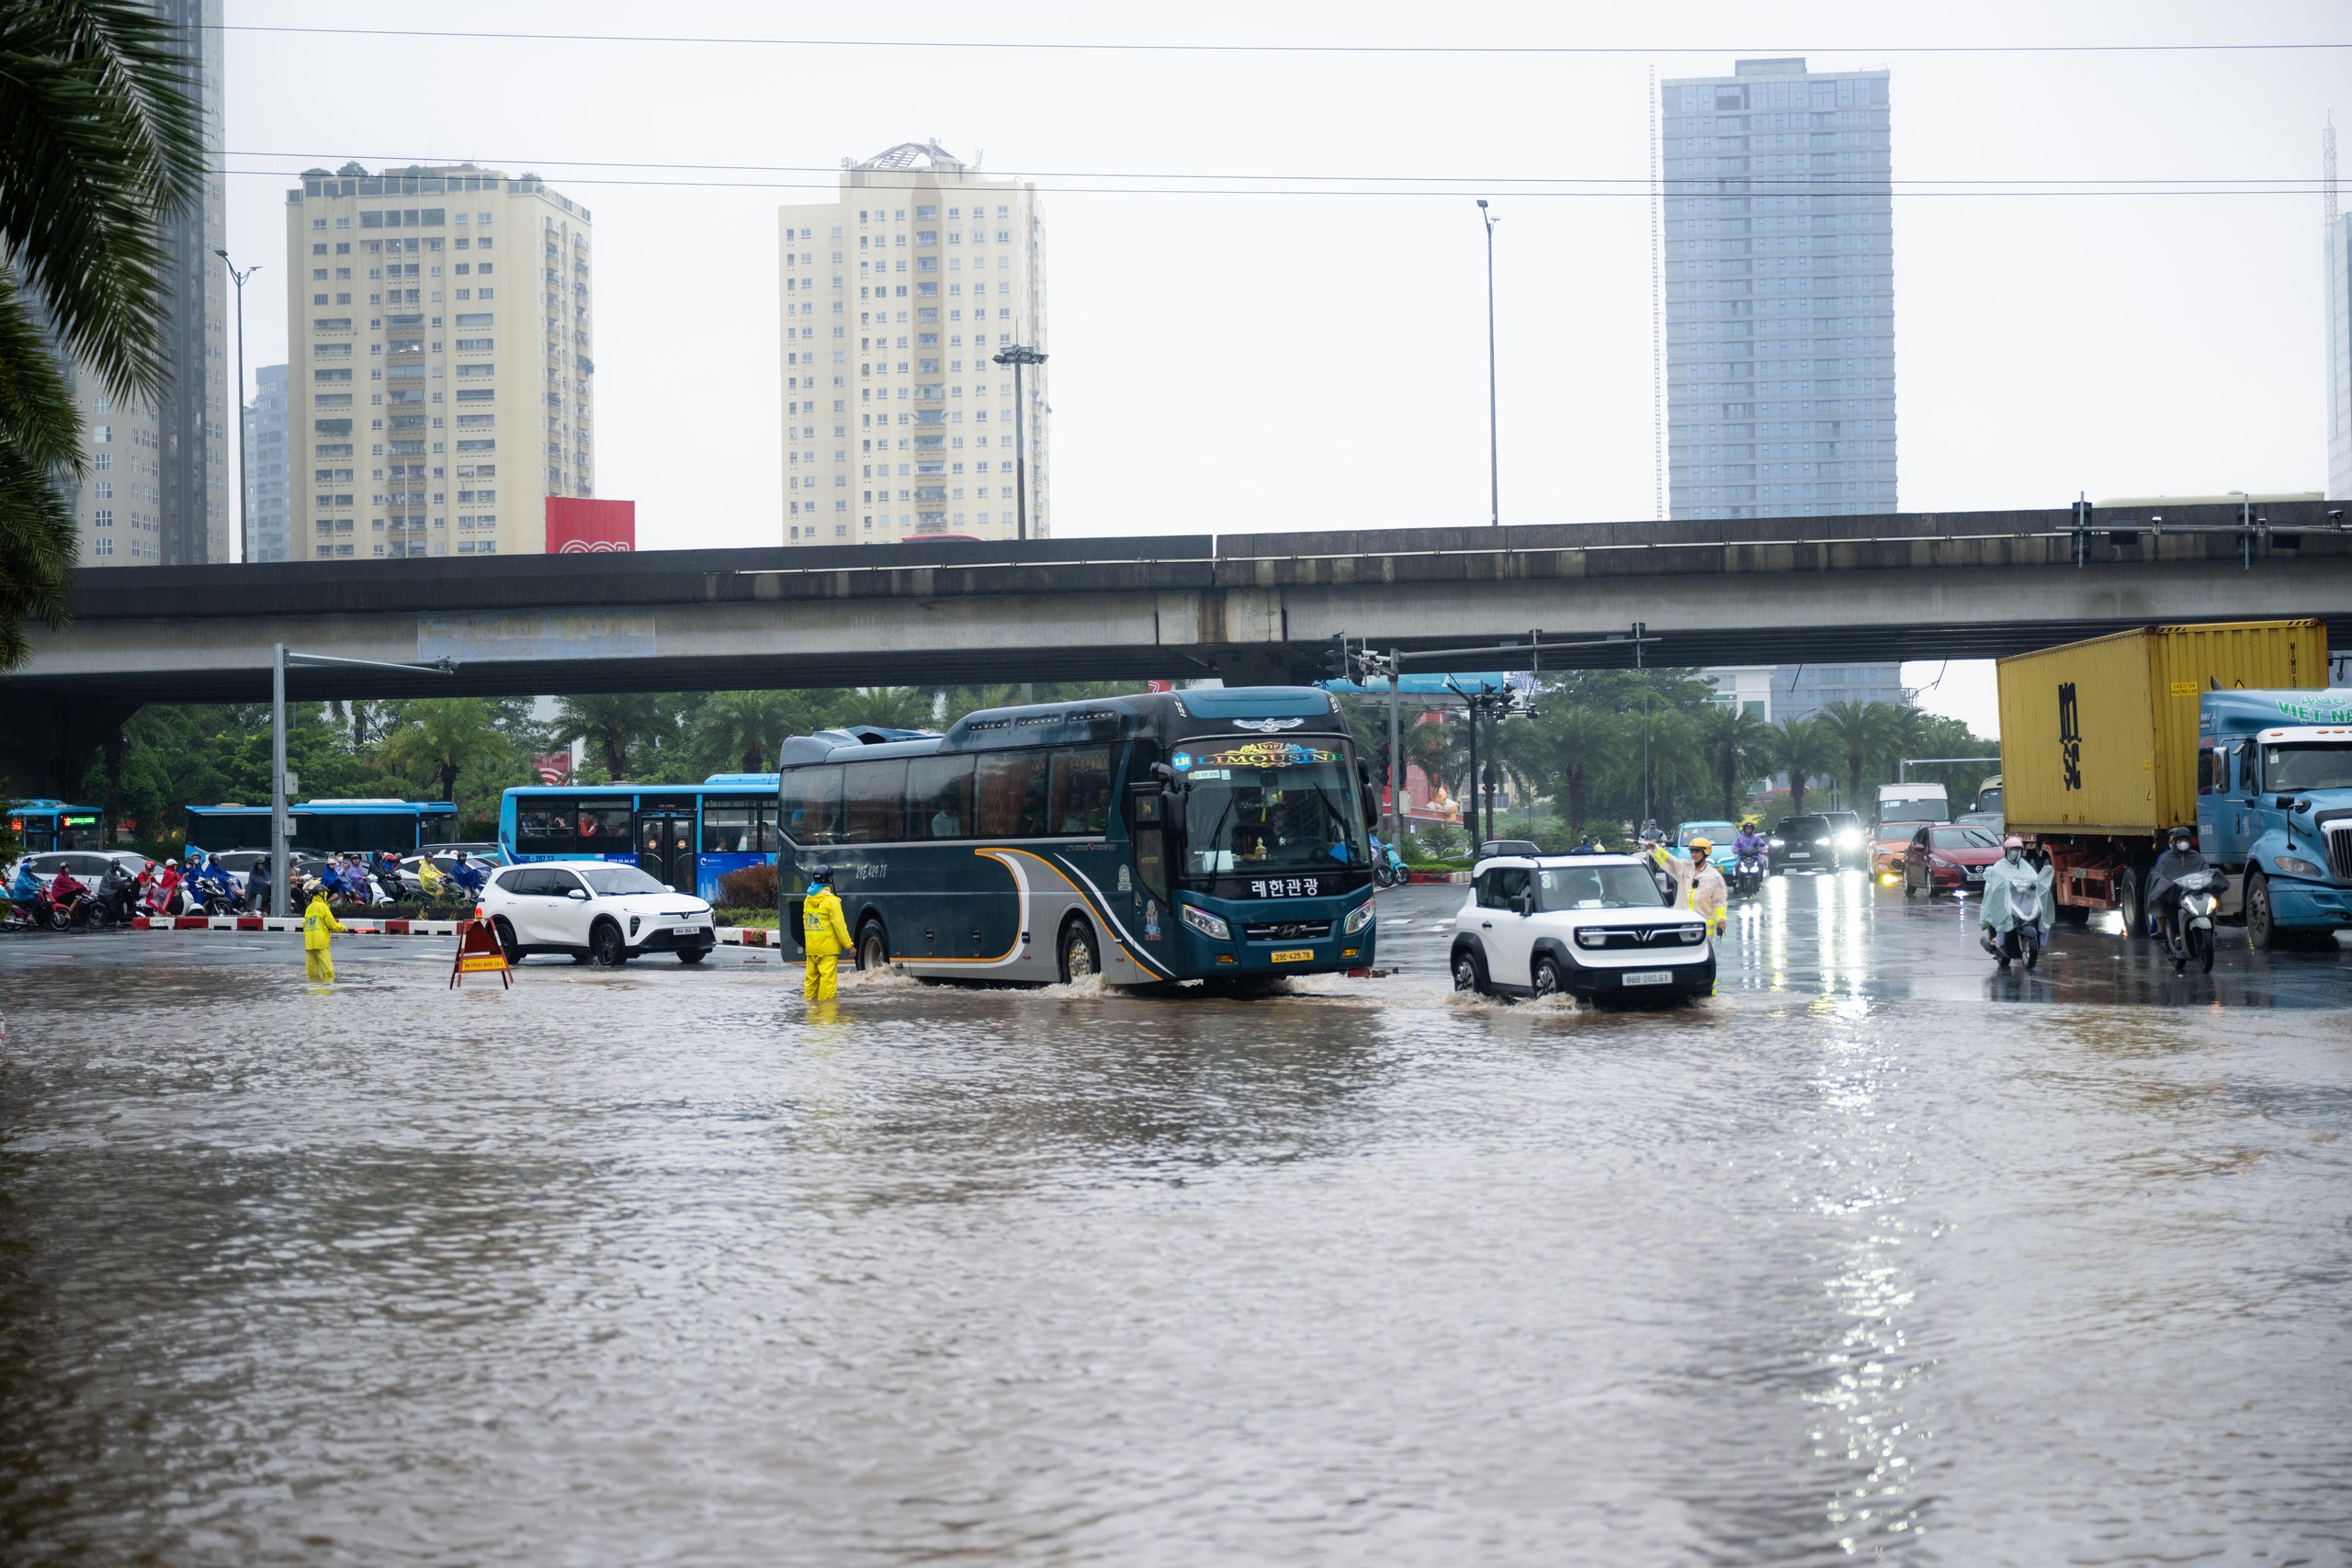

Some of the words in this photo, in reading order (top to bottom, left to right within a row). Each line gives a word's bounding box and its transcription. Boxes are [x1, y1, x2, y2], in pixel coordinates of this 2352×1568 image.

[1174, 759, 1190, 767] LH
[1197, 753, 1345, 765] LIMOUSINE
[1251, 878, 1318, 897] 레한관광
[1274, 952, 1310, 961] 29E-429.78
